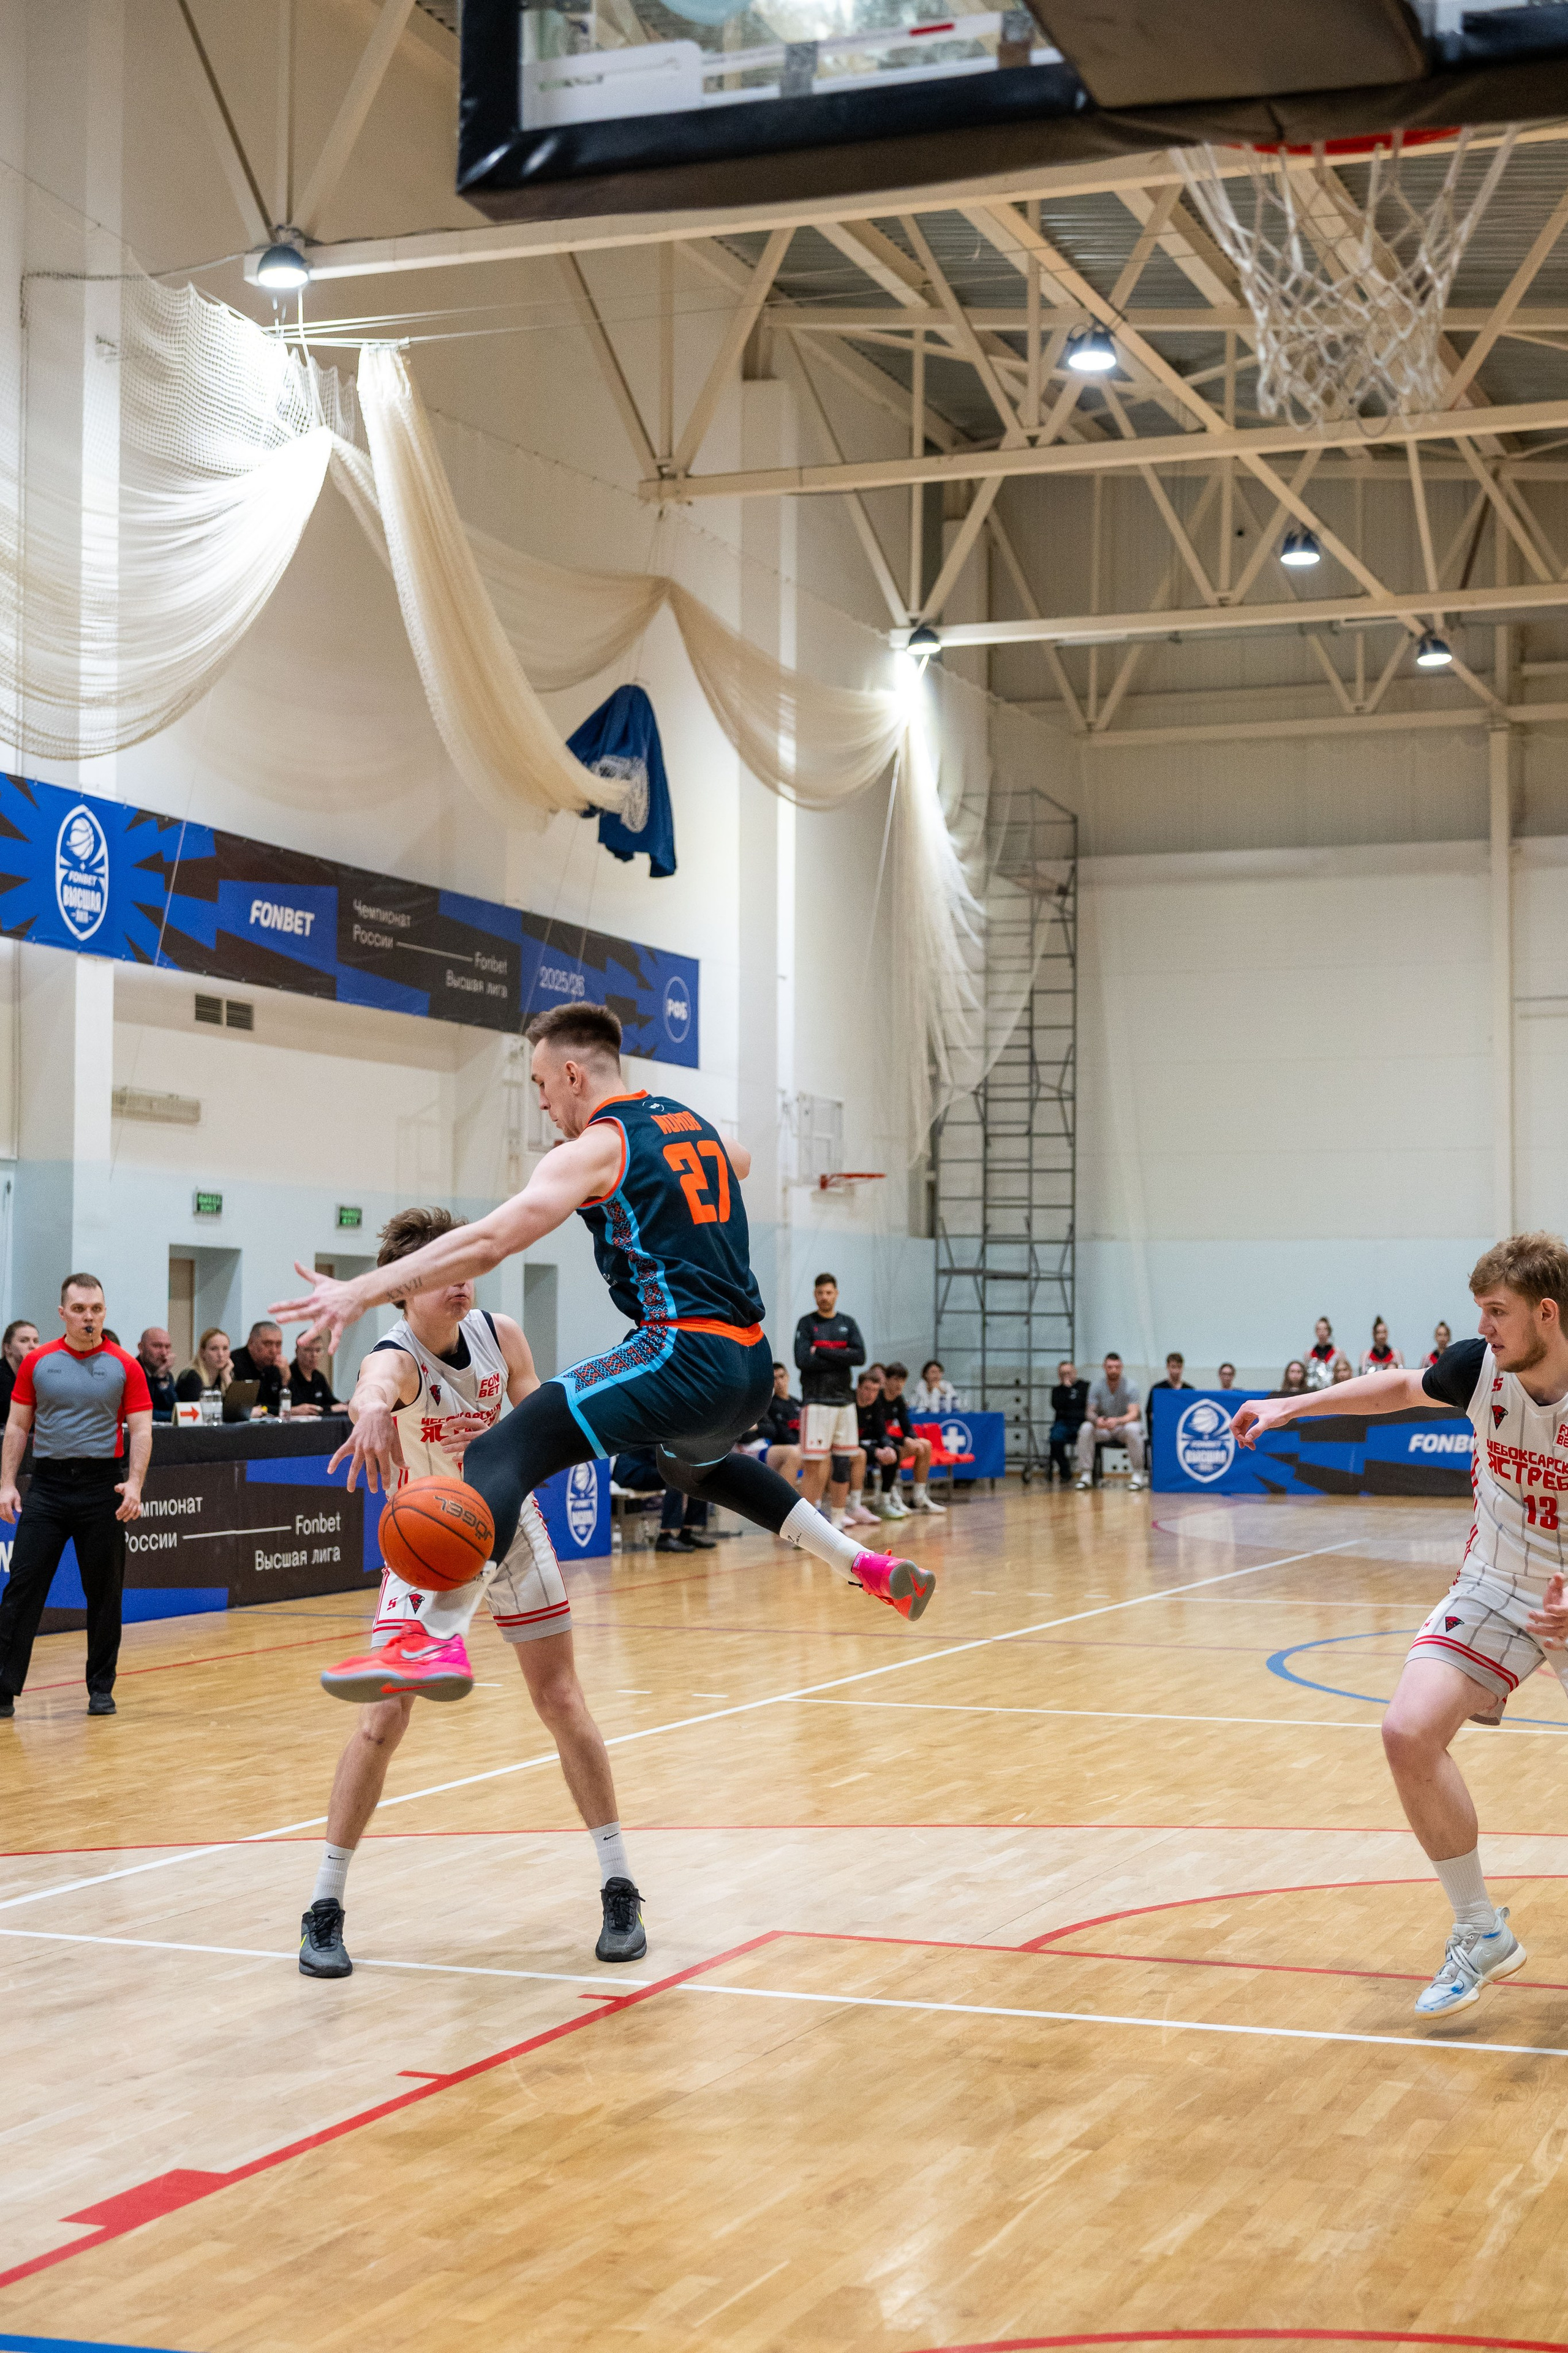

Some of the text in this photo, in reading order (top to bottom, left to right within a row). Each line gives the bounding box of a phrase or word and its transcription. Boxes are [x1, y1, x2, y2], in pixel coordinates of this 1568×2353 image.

[249, 899, 315, 937] FONBET
[352, 898, 411, 929] Чемпионат
[352, 923, 394, 949] России
[475, 951, 508, 975] Fonbet
[445, 969, 484, 993] Высшая
[540, 965, 586, 997] 2025/26
[663, 1139, 731, 1225] 27
[478, 1384, 500, 1399] BET
[480, 1373, 500, 1389] FON
[1556, 1433, 1568, 1448] BE
[1559, 1423, 1568, 1438] FO
[1408, 1433, 1474, 1454] FONB
[1487, 1438, 1568, 1475] ЧЕБОКСАРСК
[1487, 1451, 1568, 1492] ЯСТРЕБ
[140, 1497, 203, 1519] мпионат
[1523, 1494, 1559, 1531] 13
[295, 1511, 342, 1536] Fonbet
[254, 1545, 341, 1571] Высшая лига
